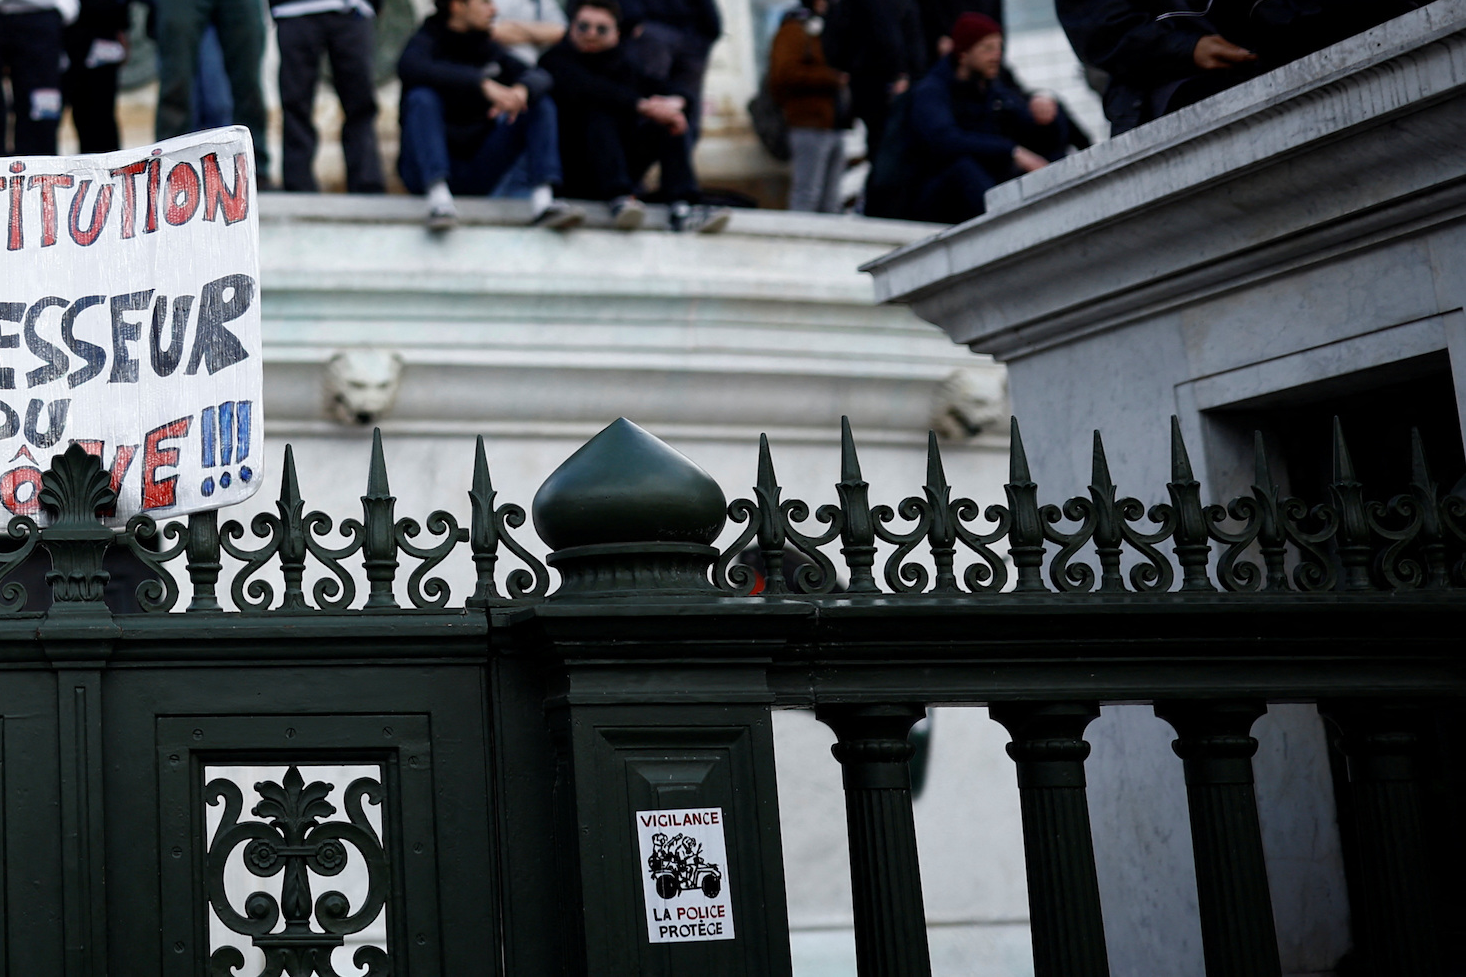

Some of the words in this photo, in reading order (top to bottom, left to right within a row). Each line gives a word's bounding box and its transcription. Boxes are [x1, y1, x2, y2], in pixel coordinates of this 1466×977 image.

[640, 811, 720, 828] VIGILANCE
[653, 908, 672, 922] LA
[676, 905, 726, 921] POLICE
